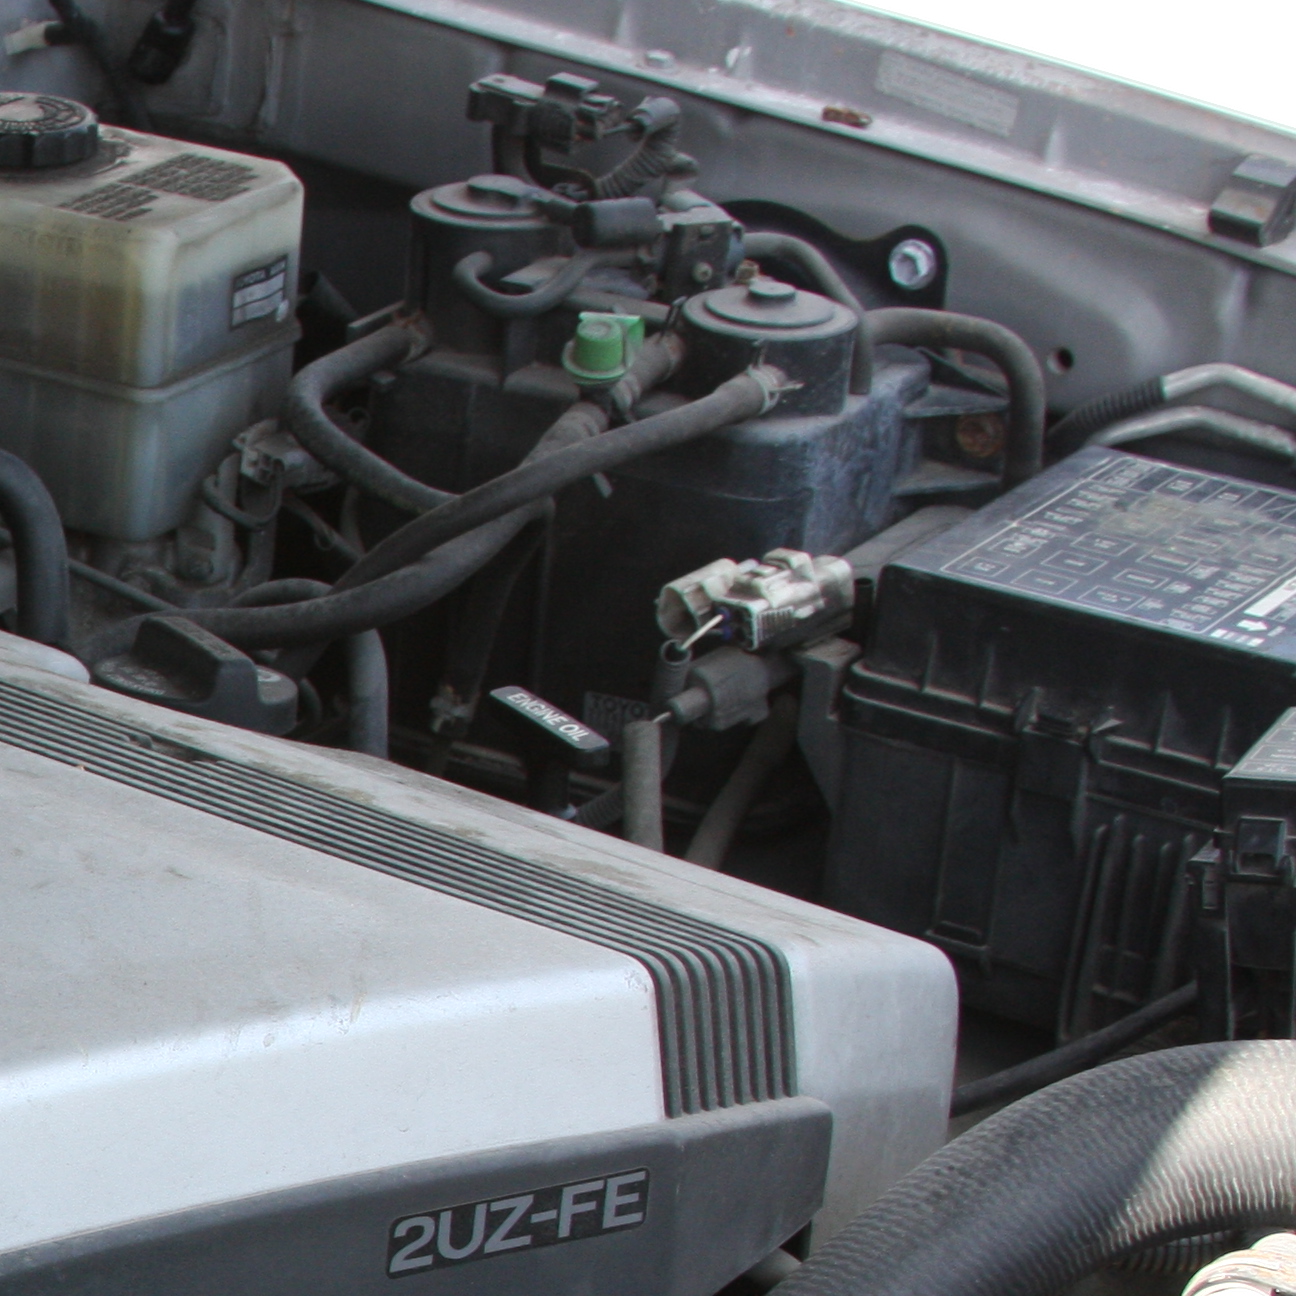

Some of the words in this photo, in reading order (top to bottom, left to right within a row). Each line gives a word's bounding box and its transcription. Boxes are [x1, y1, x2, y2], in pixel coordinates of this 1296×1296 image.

[507, 692, 569, 727] ENGINE
[559, 723, 590, 742] OIL
[389, 1170, 647, 1273] 2UZ-FE
